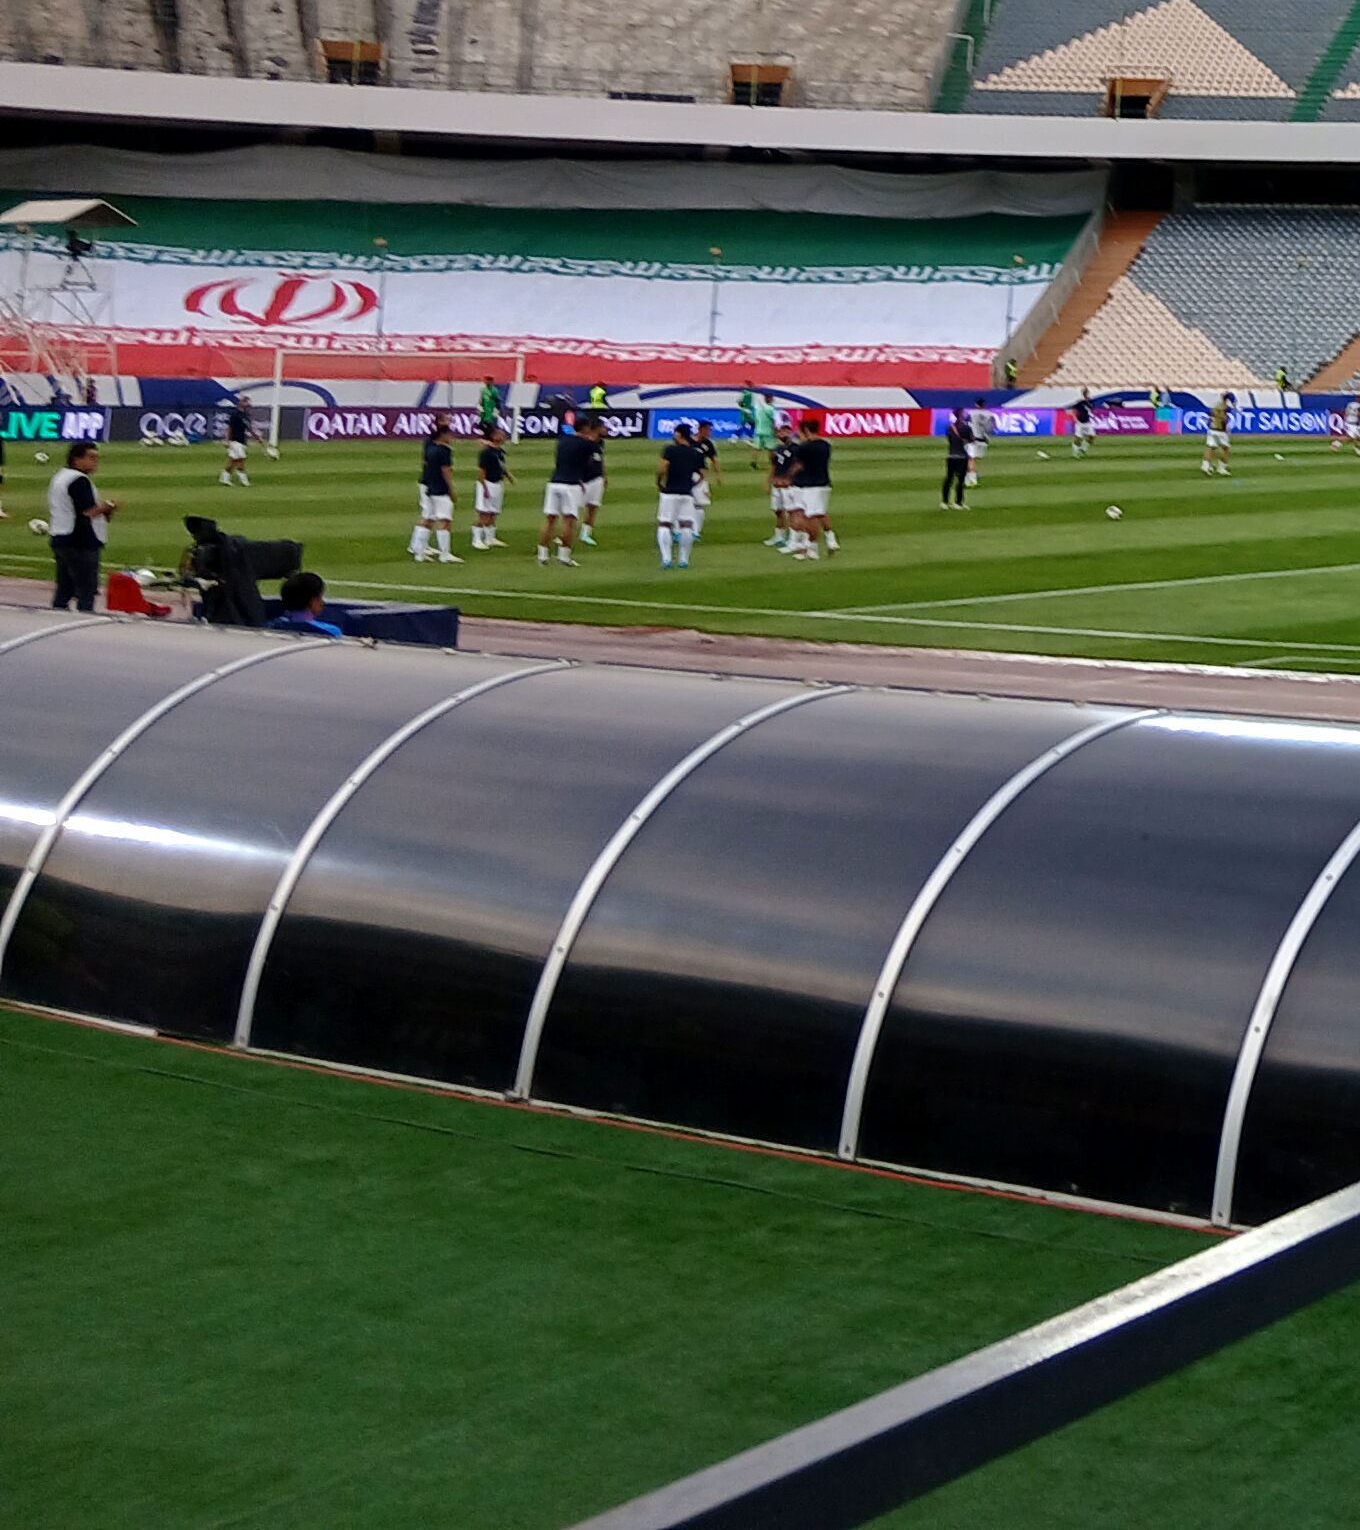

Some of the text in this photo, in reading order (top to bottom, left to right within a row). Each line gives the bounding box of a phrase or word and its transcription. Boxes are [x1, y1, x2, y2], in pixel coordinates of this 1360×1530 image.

[307, 412, 485, 440] QATAR AIRAYS
[825, 412, 900, 435] KONAMI
[1258, 411, 1327, 434] SAISON
